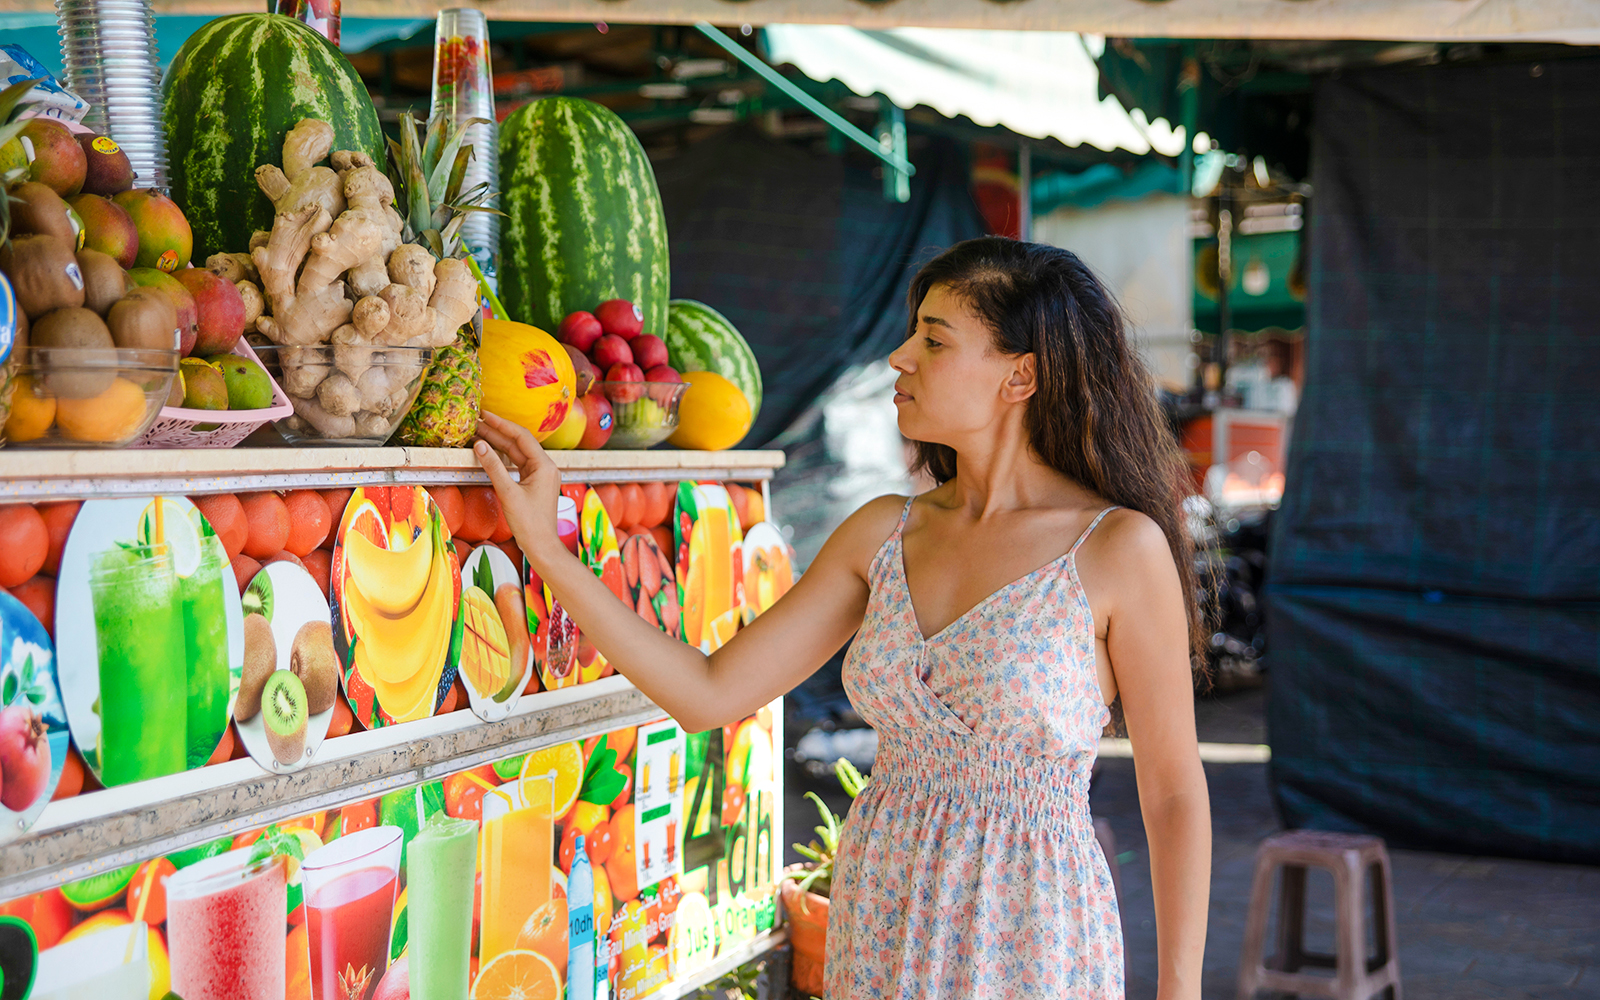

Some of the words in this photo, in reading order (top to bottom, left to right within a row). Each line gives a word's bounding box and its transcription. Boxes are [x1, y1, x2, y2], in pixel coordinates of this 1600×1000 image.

[683, 727, 775, 909] 4dh
[568, 913, 593, 938] 10dh
[687, 925, 709, 958] Jus
